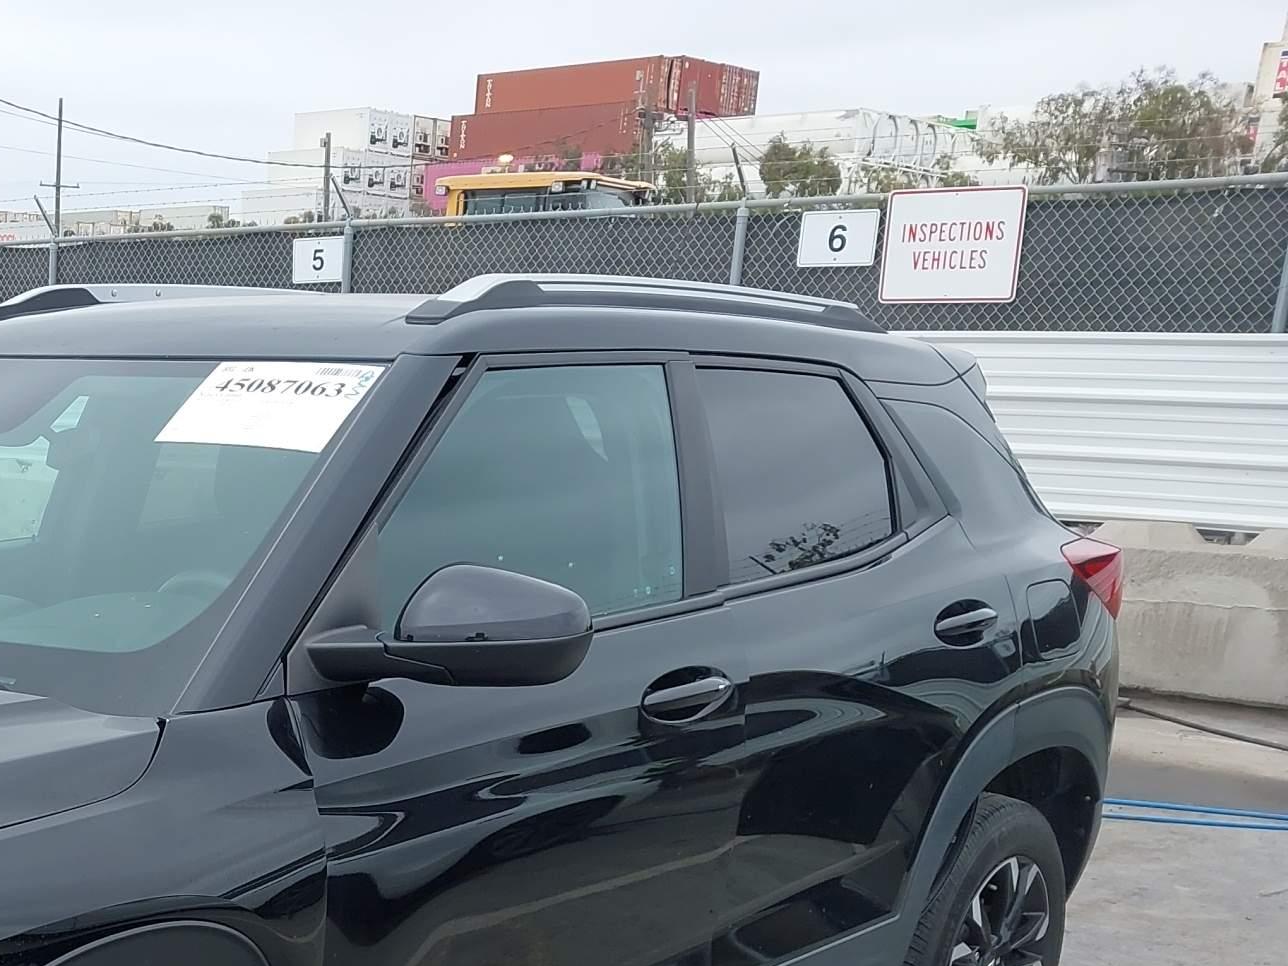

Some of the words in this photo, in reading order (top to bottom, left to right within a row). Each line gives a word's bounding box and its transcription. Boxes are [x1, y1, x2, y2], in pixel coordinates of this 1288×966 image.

[827, 224, 848, 253] 6
[901, 220, 1006, 243] INSPECTIONS
[312, 248, 324, 271] 5
[912, 250, 988, 270] VEHICLES
[215, 378, 346, 398] 45087063
